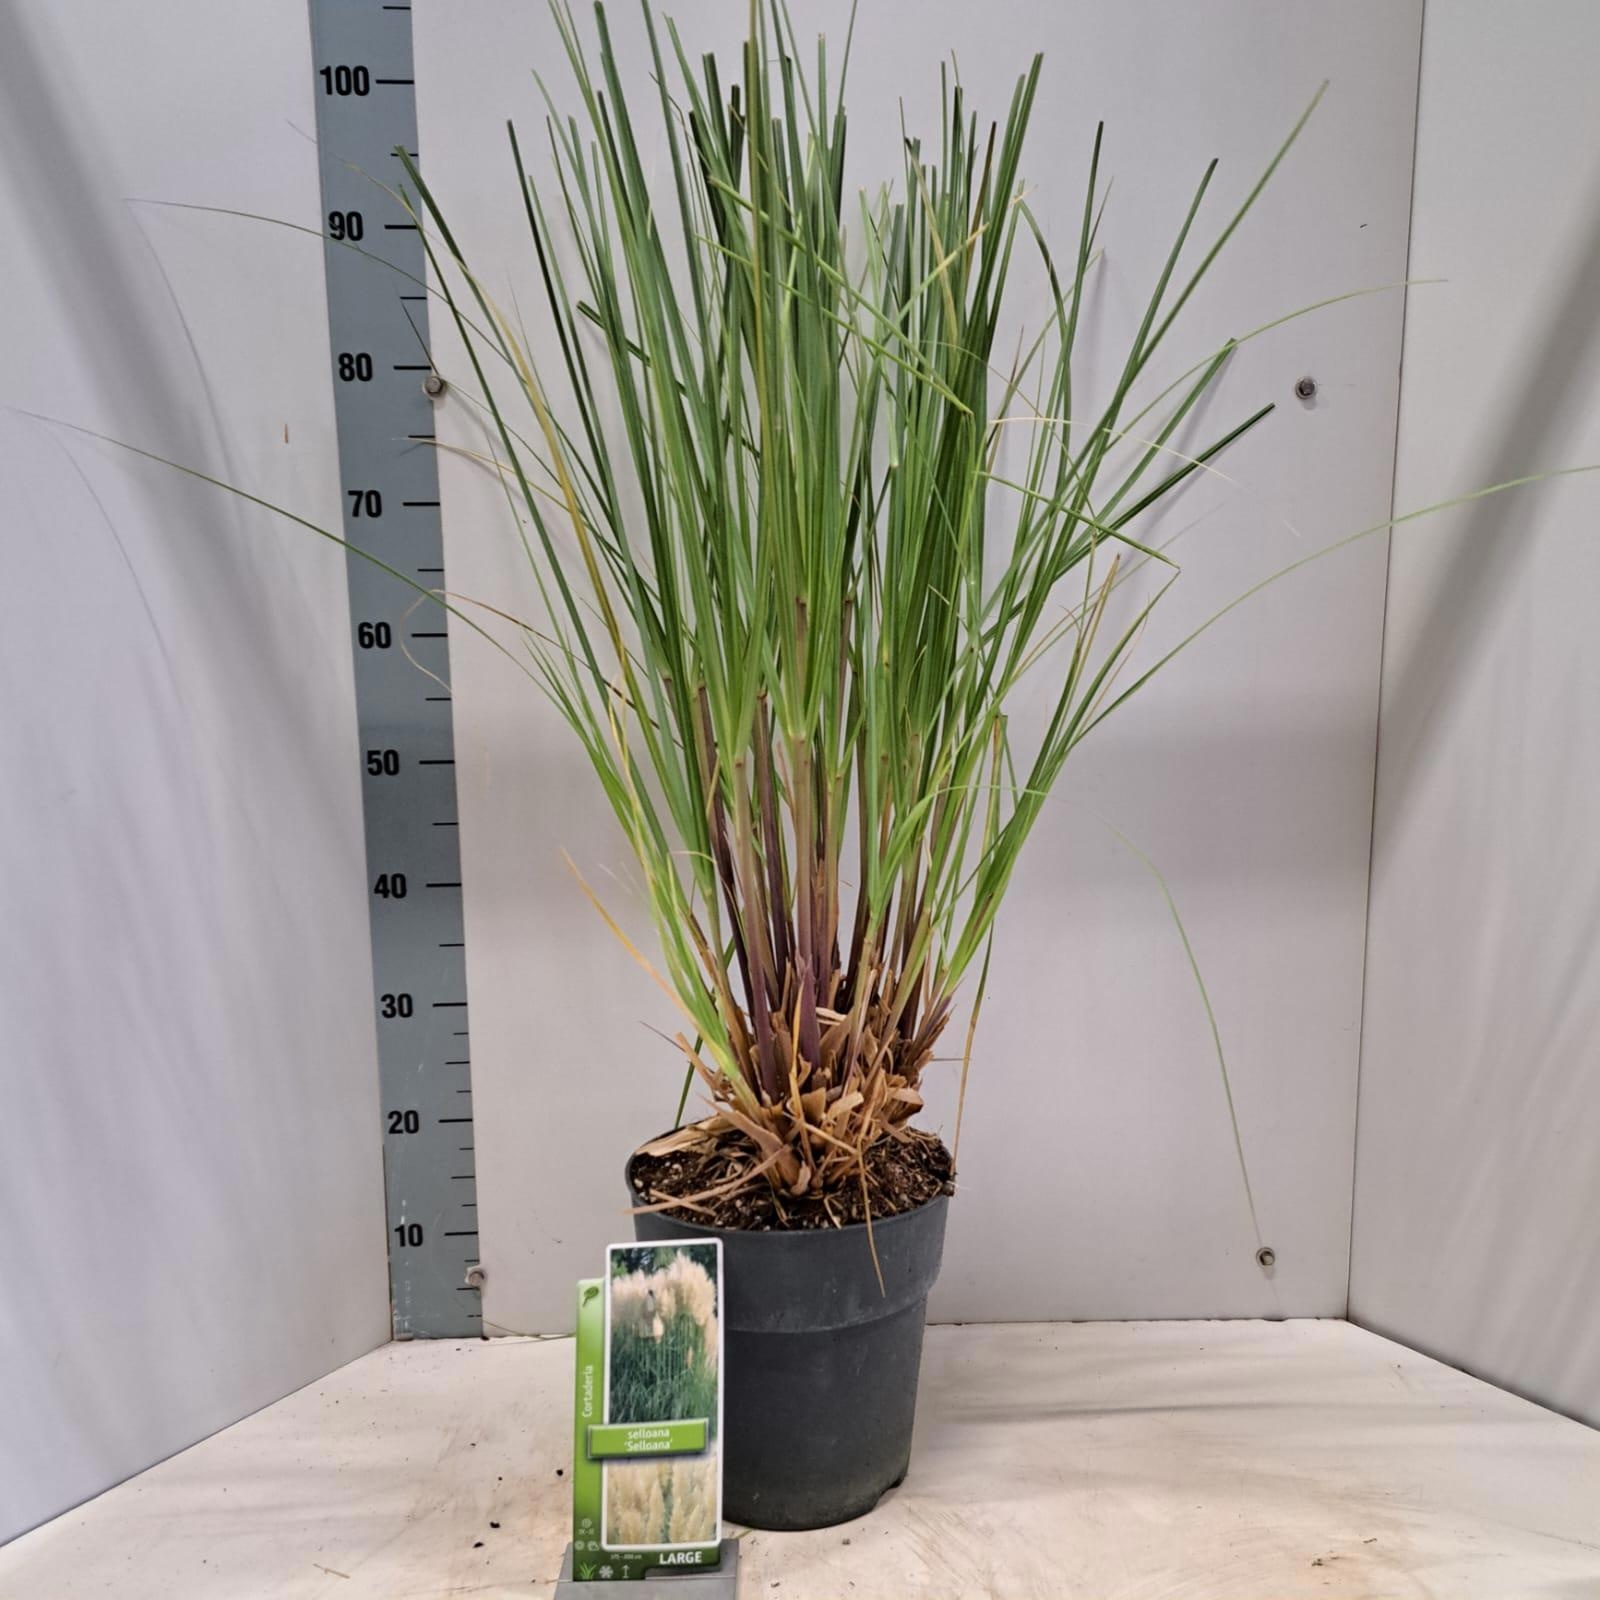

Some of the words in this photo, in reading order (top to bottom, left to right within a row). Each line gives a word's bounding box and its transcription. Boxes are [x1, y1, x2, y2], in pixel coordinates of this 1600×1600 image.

[319, 65, 371, 97] 100
[328, 210, 364, 242] 90
[337, 352, 374, 383] 80
[347, 489, 383, 519] 70
[357, 621, 392, 650] 60
[366, 748, 401, 777] 50
[373, 872, 408, 900] 40
[380, 993, 414, 1019] 30
[387, 1109, 420, 1135] 20
[395, 1223, 424, 1248] 10
[581, 1364, 594, 1418] Cortaderia
[627, 1427, 670, 1440] selloana
[659, 1551, 702, 1565] LARGE
